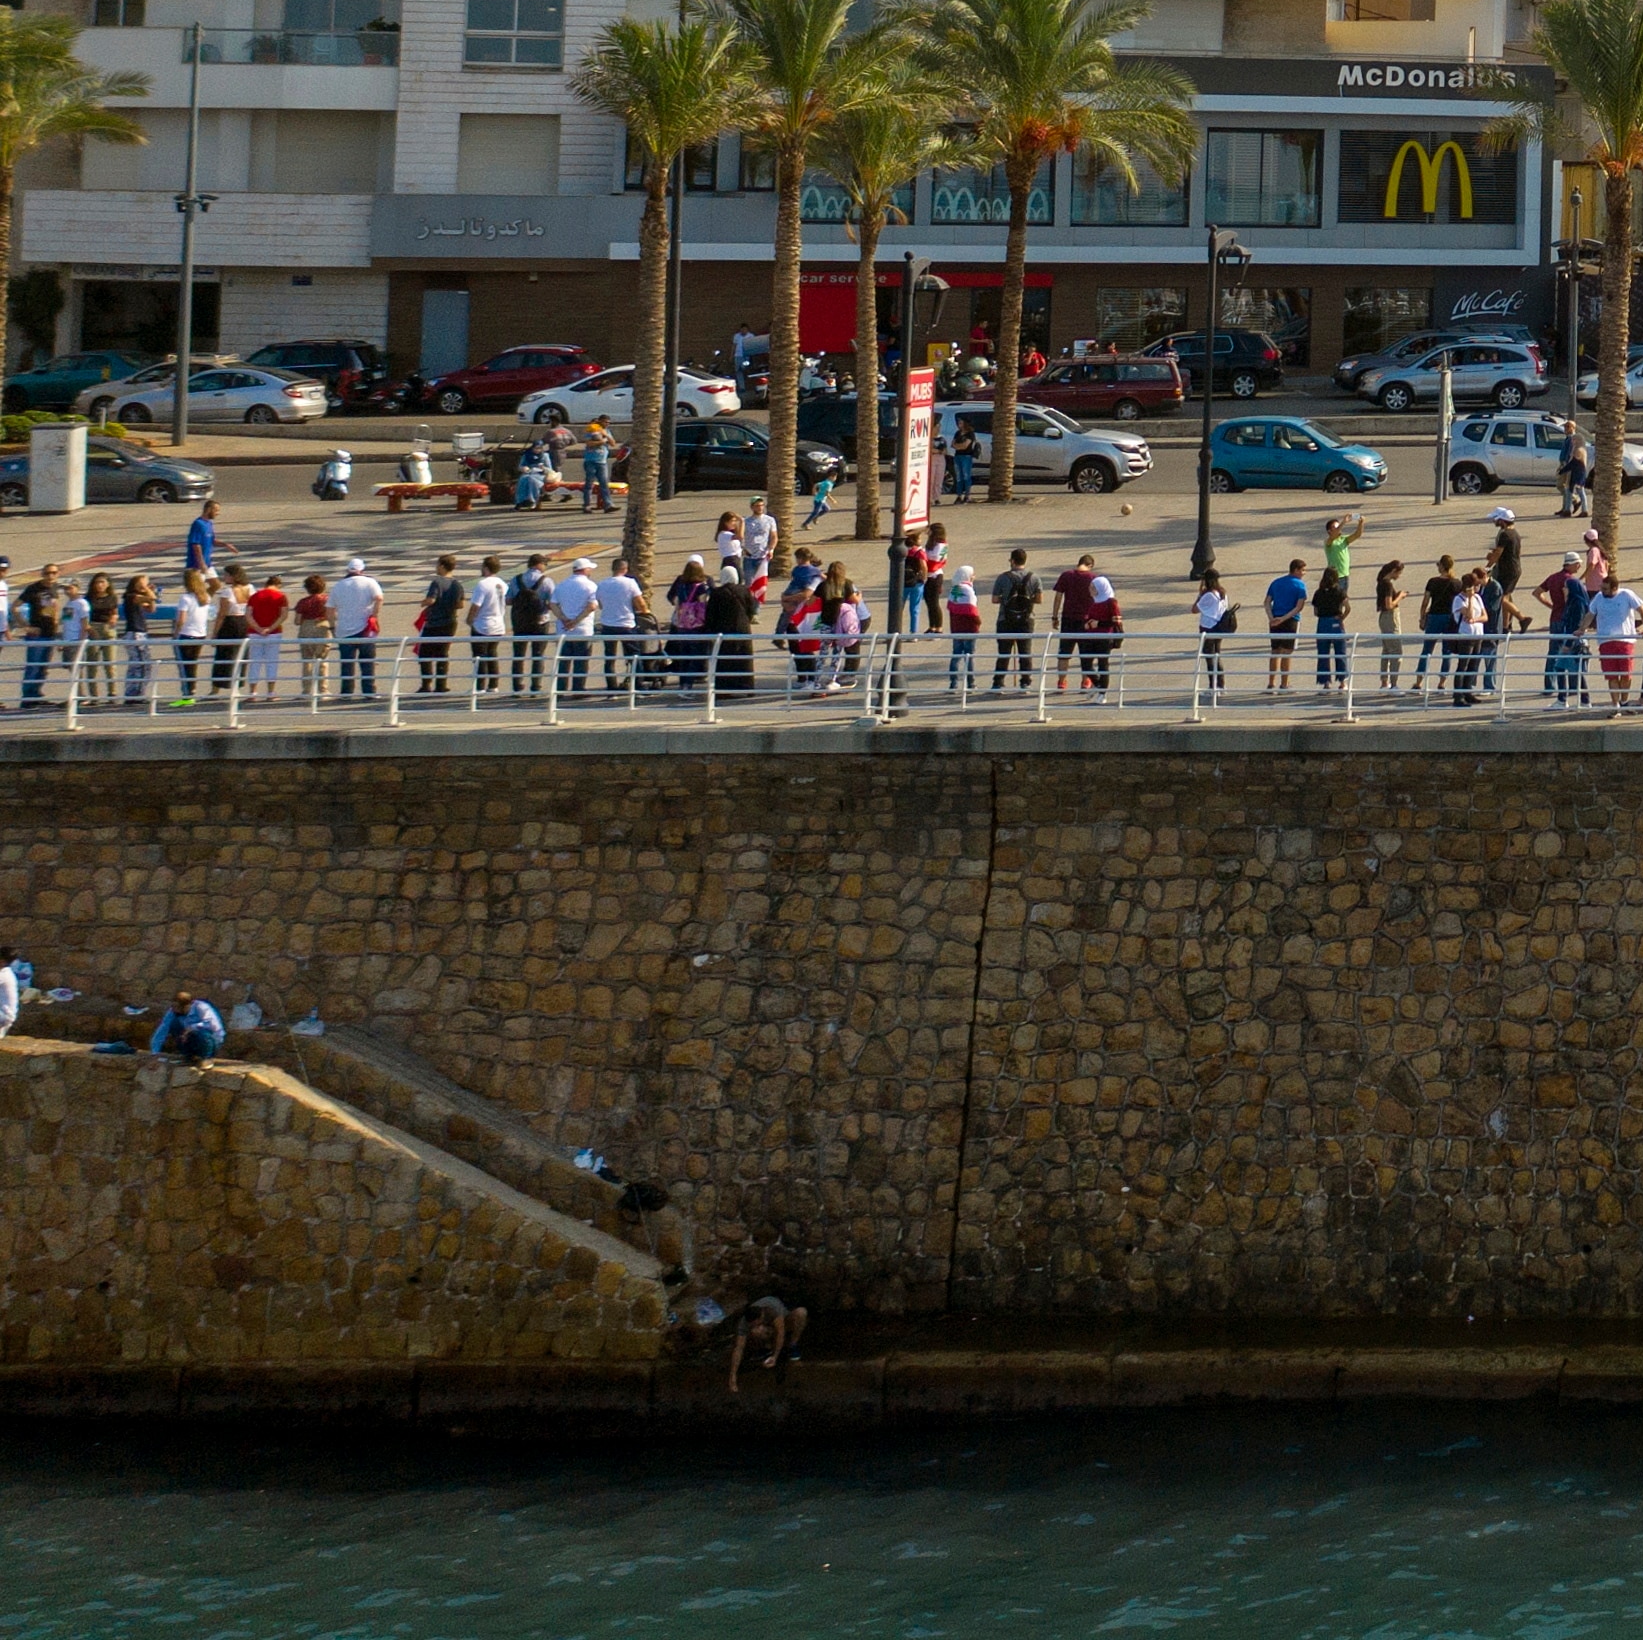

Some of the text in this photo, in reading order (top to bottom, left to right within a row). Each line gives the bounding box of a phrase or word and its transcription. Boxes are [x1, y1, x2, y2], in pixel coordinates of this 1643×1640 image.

[800, 274, 825, 284] car
[1451, 289, 1528, 320] McCafé
[910, 381, 933, 402] MUBS
